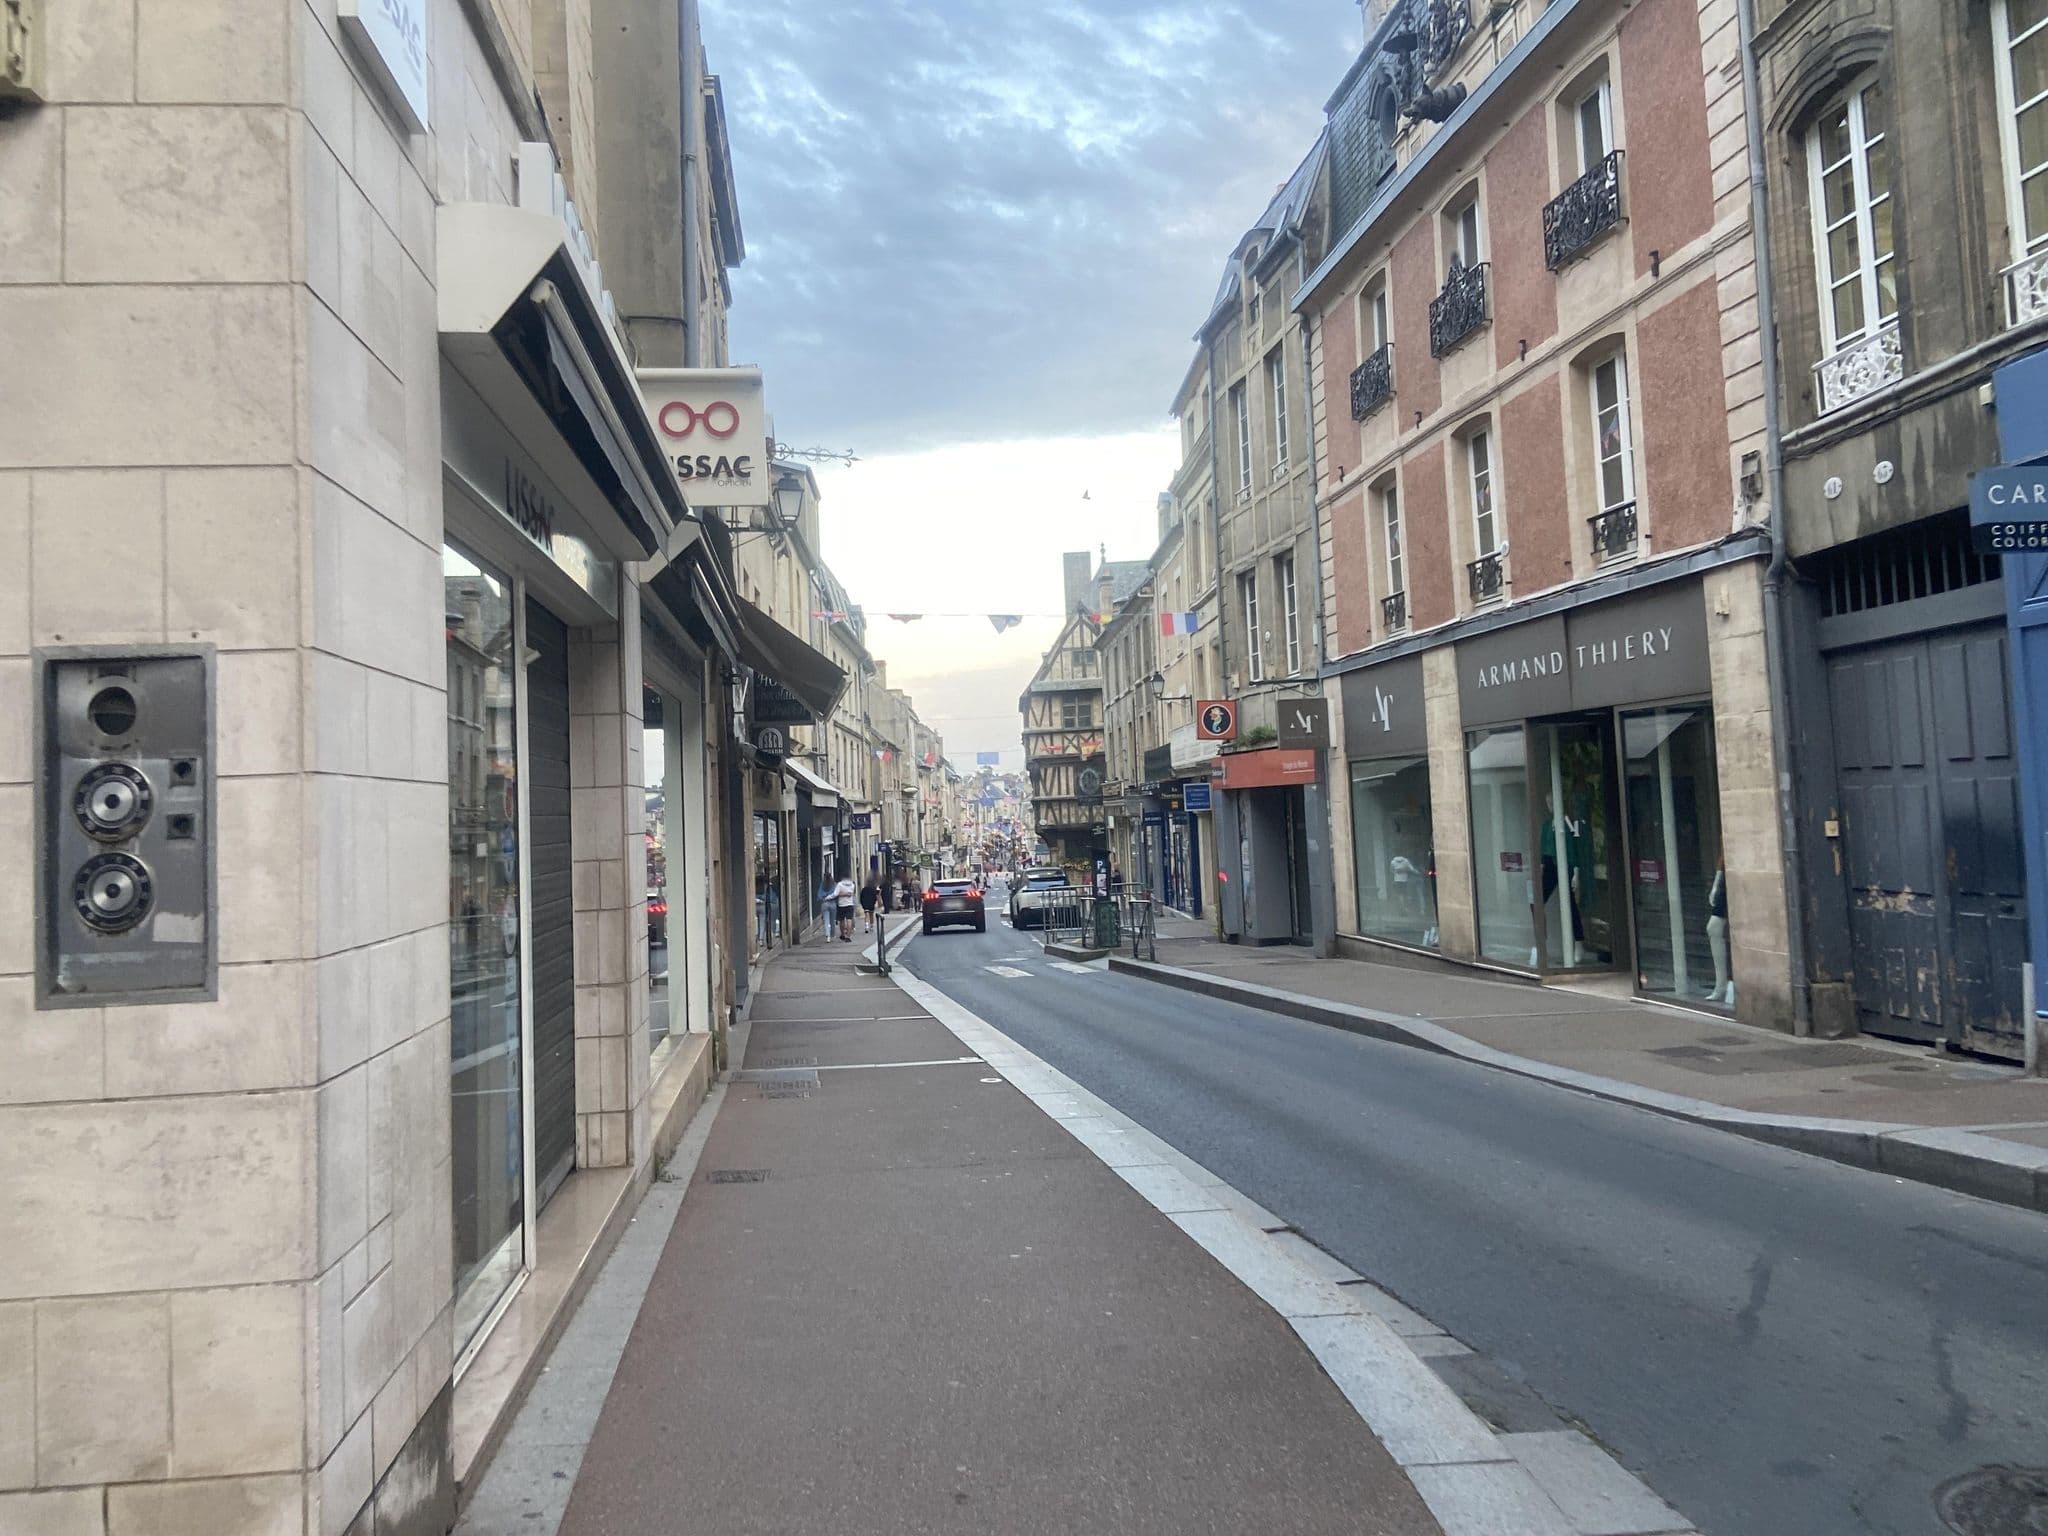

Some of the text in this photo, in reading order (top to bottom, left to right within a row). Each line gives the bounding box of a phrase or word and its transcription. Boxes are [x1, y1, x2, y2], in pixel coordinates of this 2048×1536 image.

[670, 455, 751, 479] SSAC
[1477, 626, 1673, 689] ARMAND THIERY
